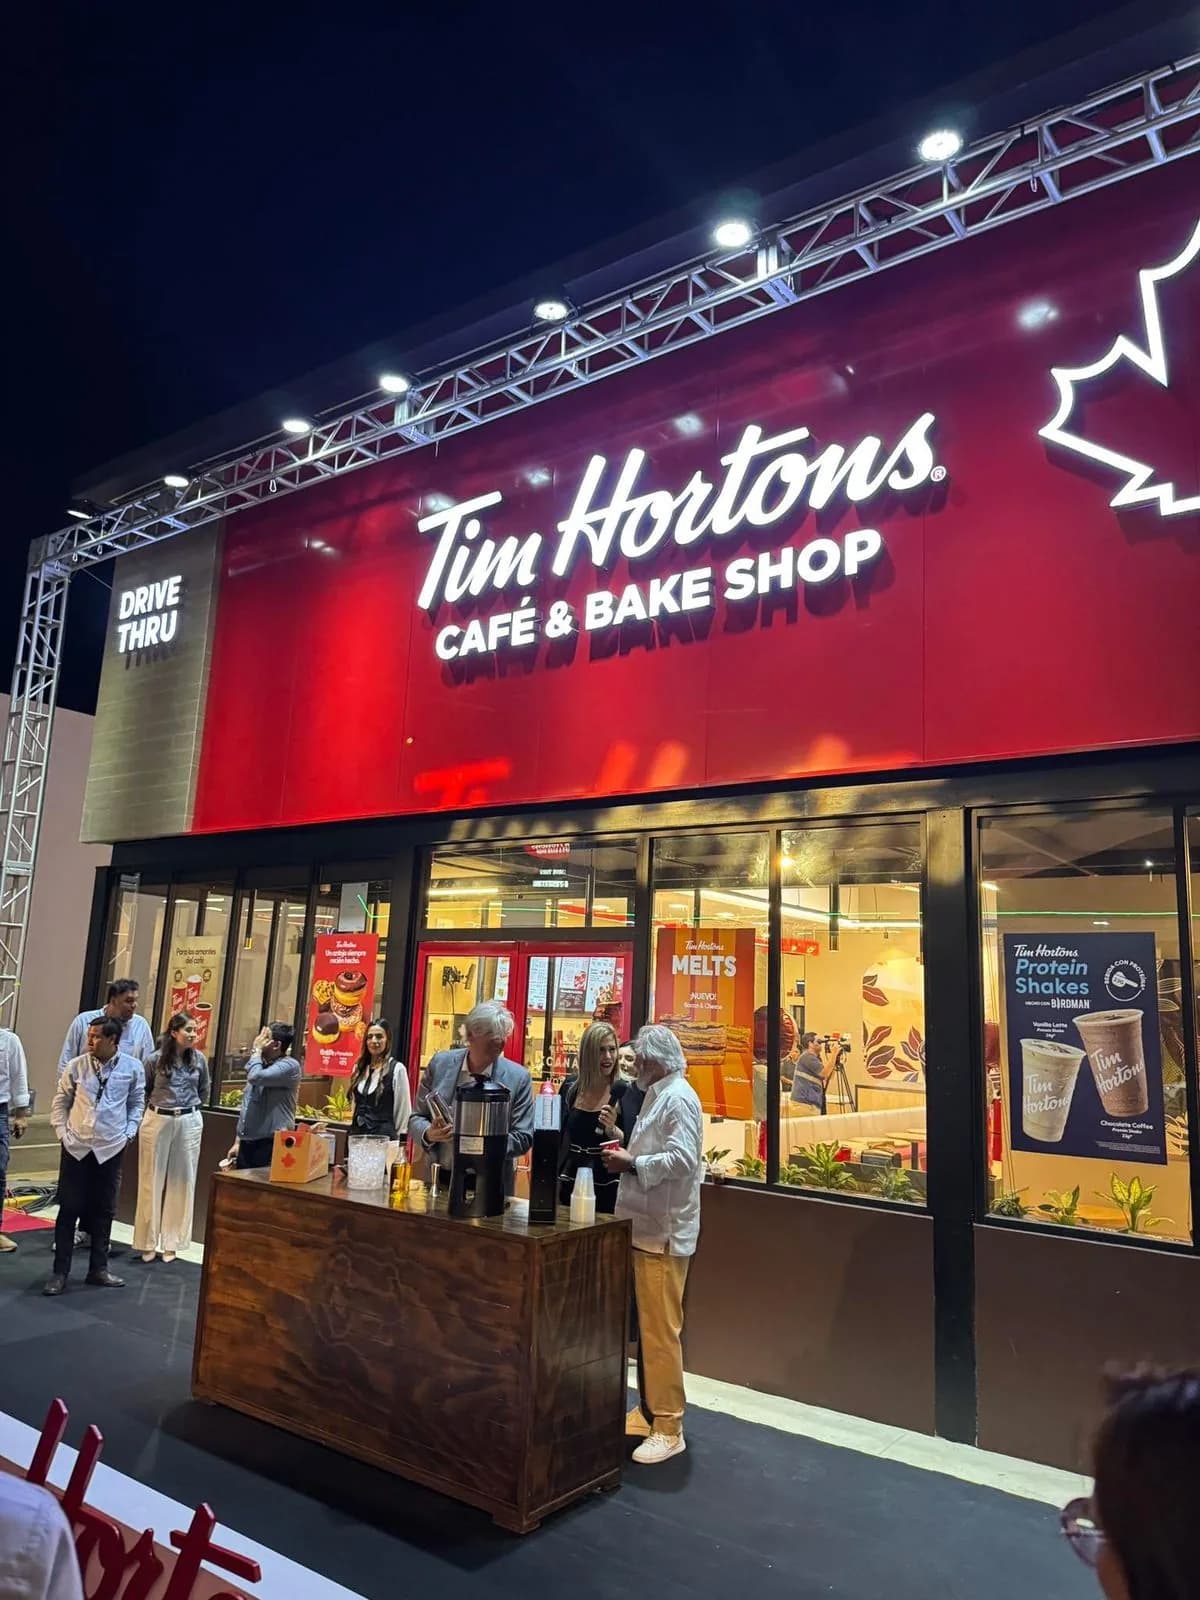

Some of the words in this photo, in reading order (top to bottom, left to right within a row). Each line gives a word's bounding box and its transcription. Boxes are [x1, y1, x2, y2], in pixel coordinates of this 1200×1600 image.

[418, 491, 542, 610] Tim
[119, 575, 182, 620] DRIVE
[435, 597, 536, 661] CAFÉ
[545, 601, 574, 638] &
[585, 567, 711, 631] BAKE
[724, 529, 883, 600] SHOP
[118, 610, 178, 653] THRU
[685, 939, 698, 951] Tim
[698, 940, 725, 951] Hortons
[1013, 944, 1034, 957] Tim
[1035, 943, 1079, 957] Hortons
[672, 955, 737, 977] MELTS
[1016, 958, 1088, 975] Protein
[1114, 959, 1129, 967] CON
[1016, 977, 1090, 995] Shakes
[1090, 1048, 1122, 1072] Tim
[1024, 1073, 1053, 1094] Tim
[1100, 1120, 1131, 1128] Chocolate
[1132, 1122, 1154, 1130] Coffee
